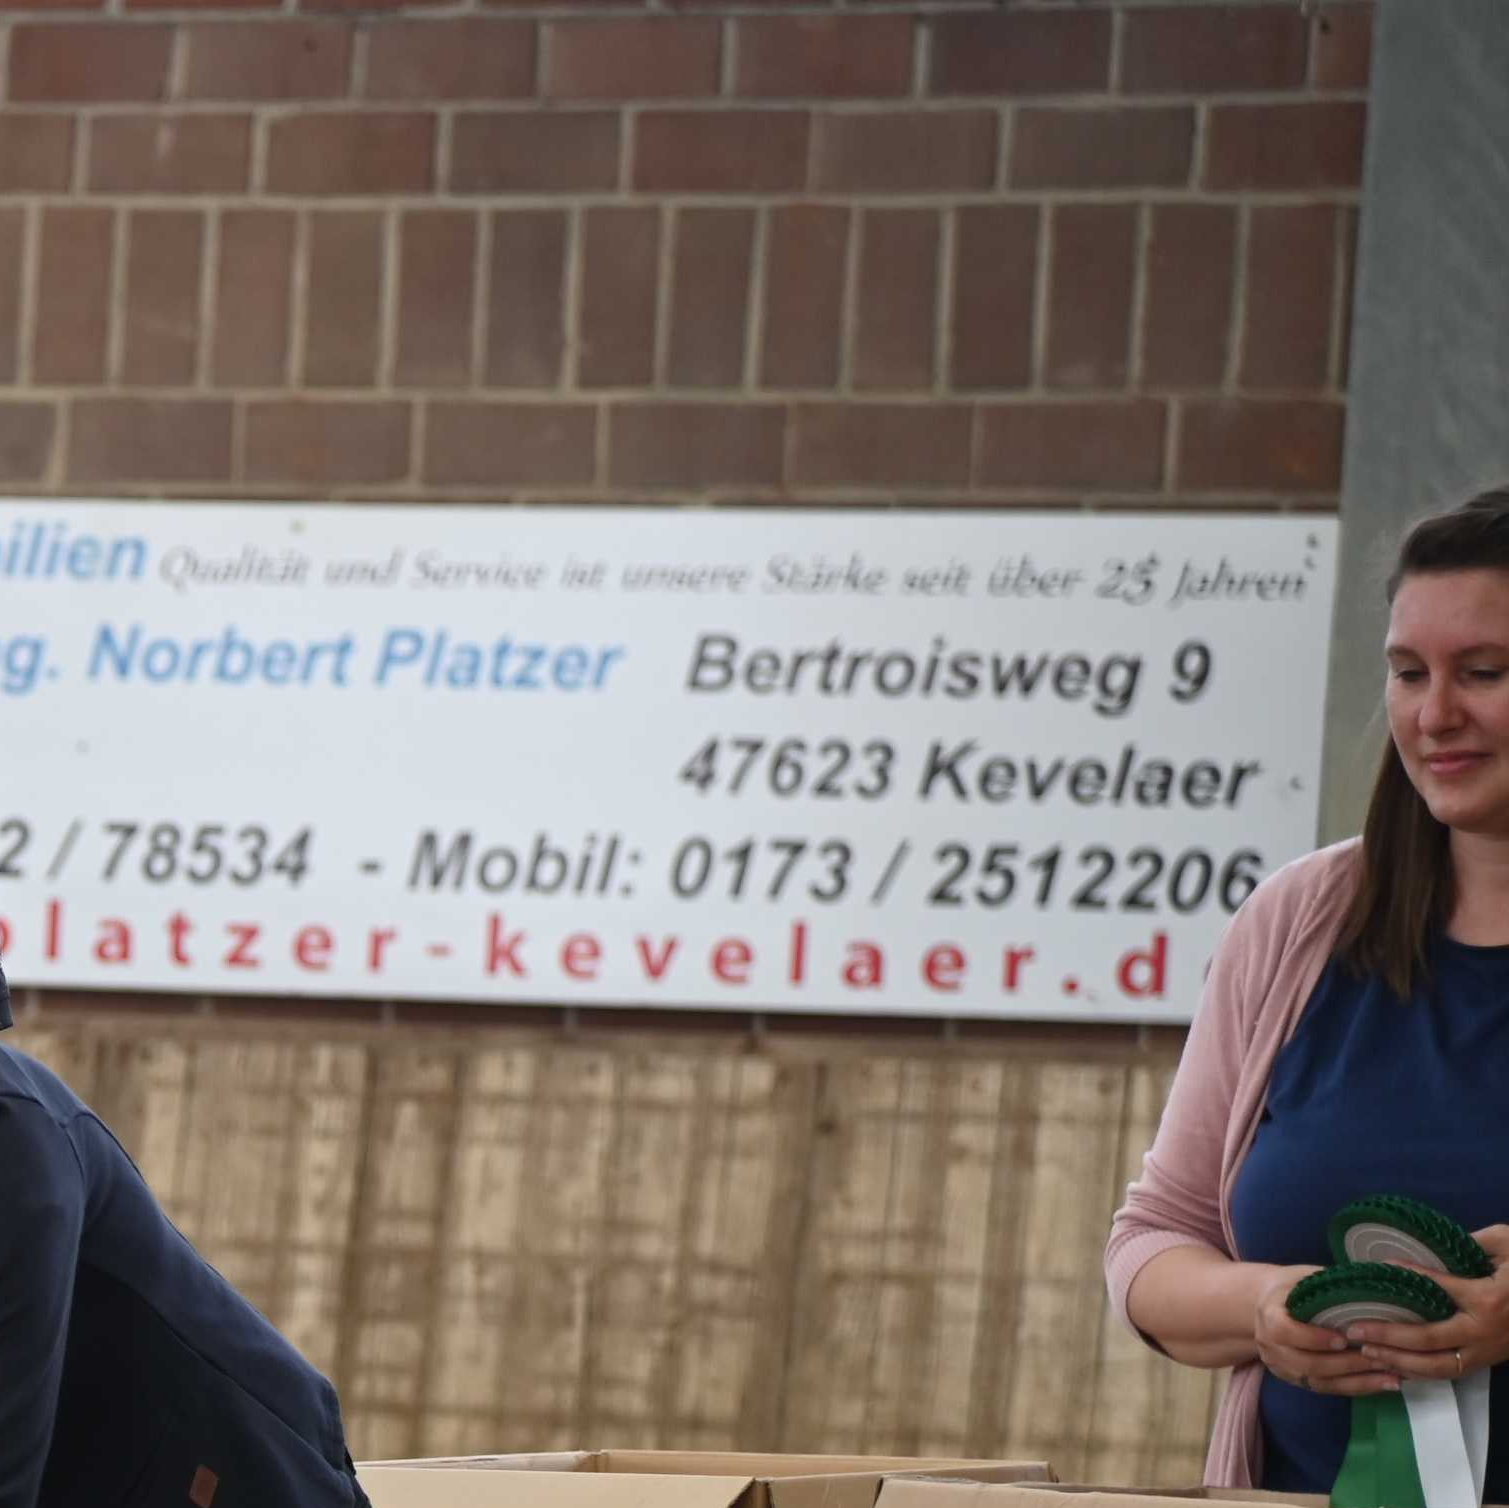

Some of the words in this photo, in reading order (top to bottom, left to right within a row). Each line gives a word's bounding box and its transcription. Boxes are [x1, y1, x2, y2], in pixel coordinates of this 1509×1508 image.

[158, 544, 310, 592] Qualität
[323, 546, 404, 587] und
[412, 549, 547, 590] Service
[560, 554, 607, 590] ist
[620, 559, 750, 594] unsere
[765, 553, 885, 595] Stärke
[903, 556, 972, 596] seit
[986, 553, 1086, 597] über
[1169, 554, 1305, 608] Jahren
[87, 624, 359, 687] Norbert
[373, 628, 626, 692] Platzer
[687, 631, 1144, 718] Bertroisweg
[1168, 639, 1213, 703] 9
[680, 736, 895, 798] 47623
[918, 738, 1263, 808] Kevelaer
[101, 820, 313, 886] 78534
[407, 829, 642, 898] Mobil:
[669, 836, 853, 902] 0173
[926, 841, 1262, 915] 2512206
